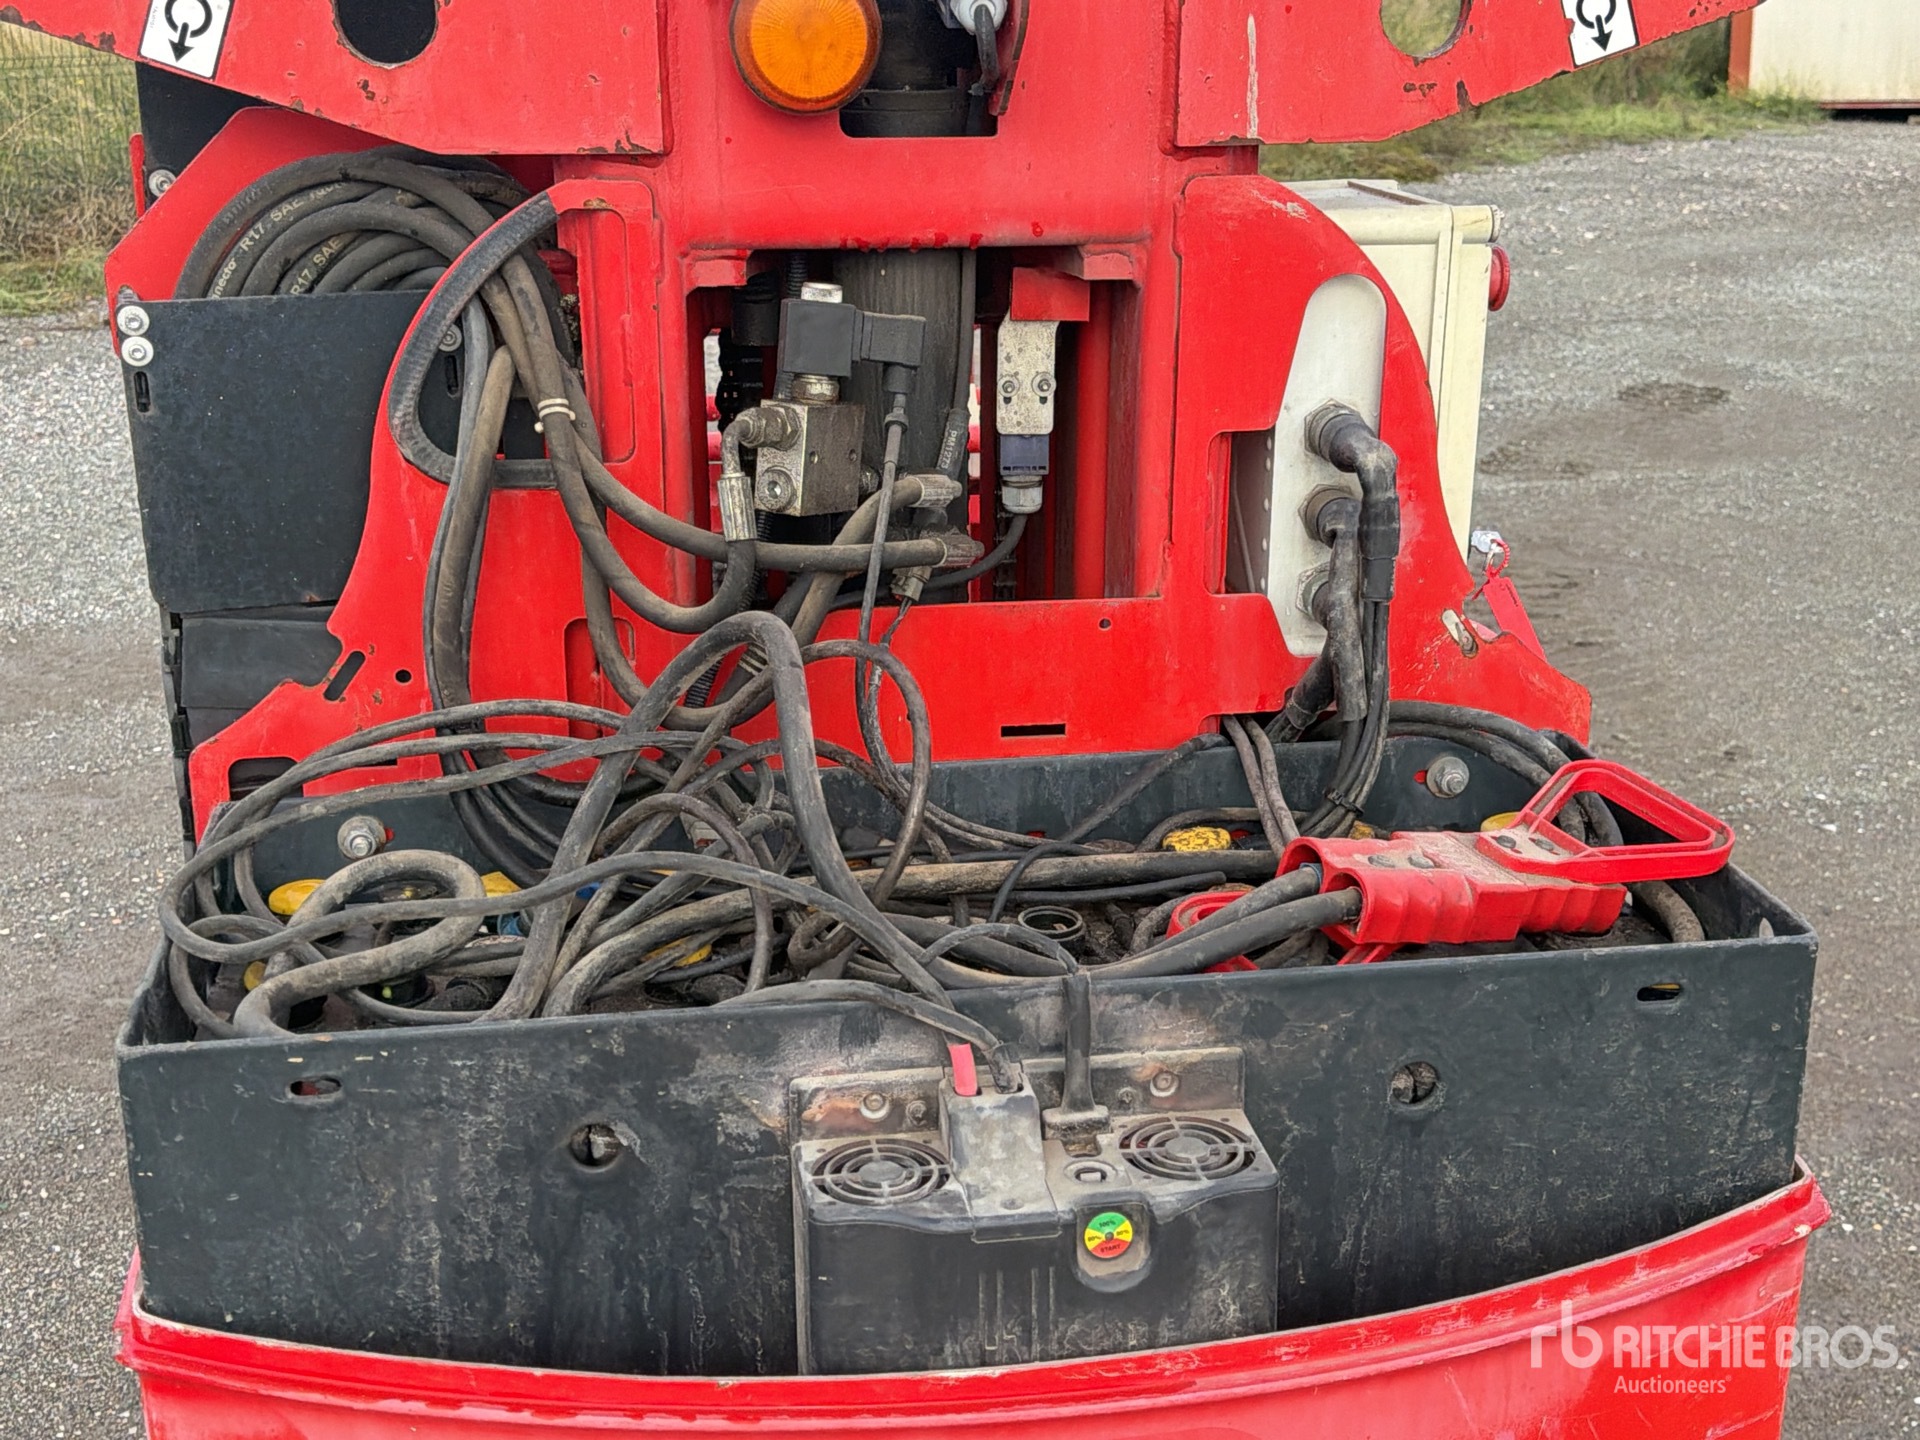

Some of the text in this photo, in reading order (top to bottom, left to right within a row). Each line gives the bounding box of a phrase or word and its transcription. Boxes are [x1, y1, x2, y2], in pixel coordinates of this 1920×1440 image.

[240, 222, 265, 251] R17
[270, 199, 304, 221] SAE
[290, 238, 343, 296] R17 SAE
